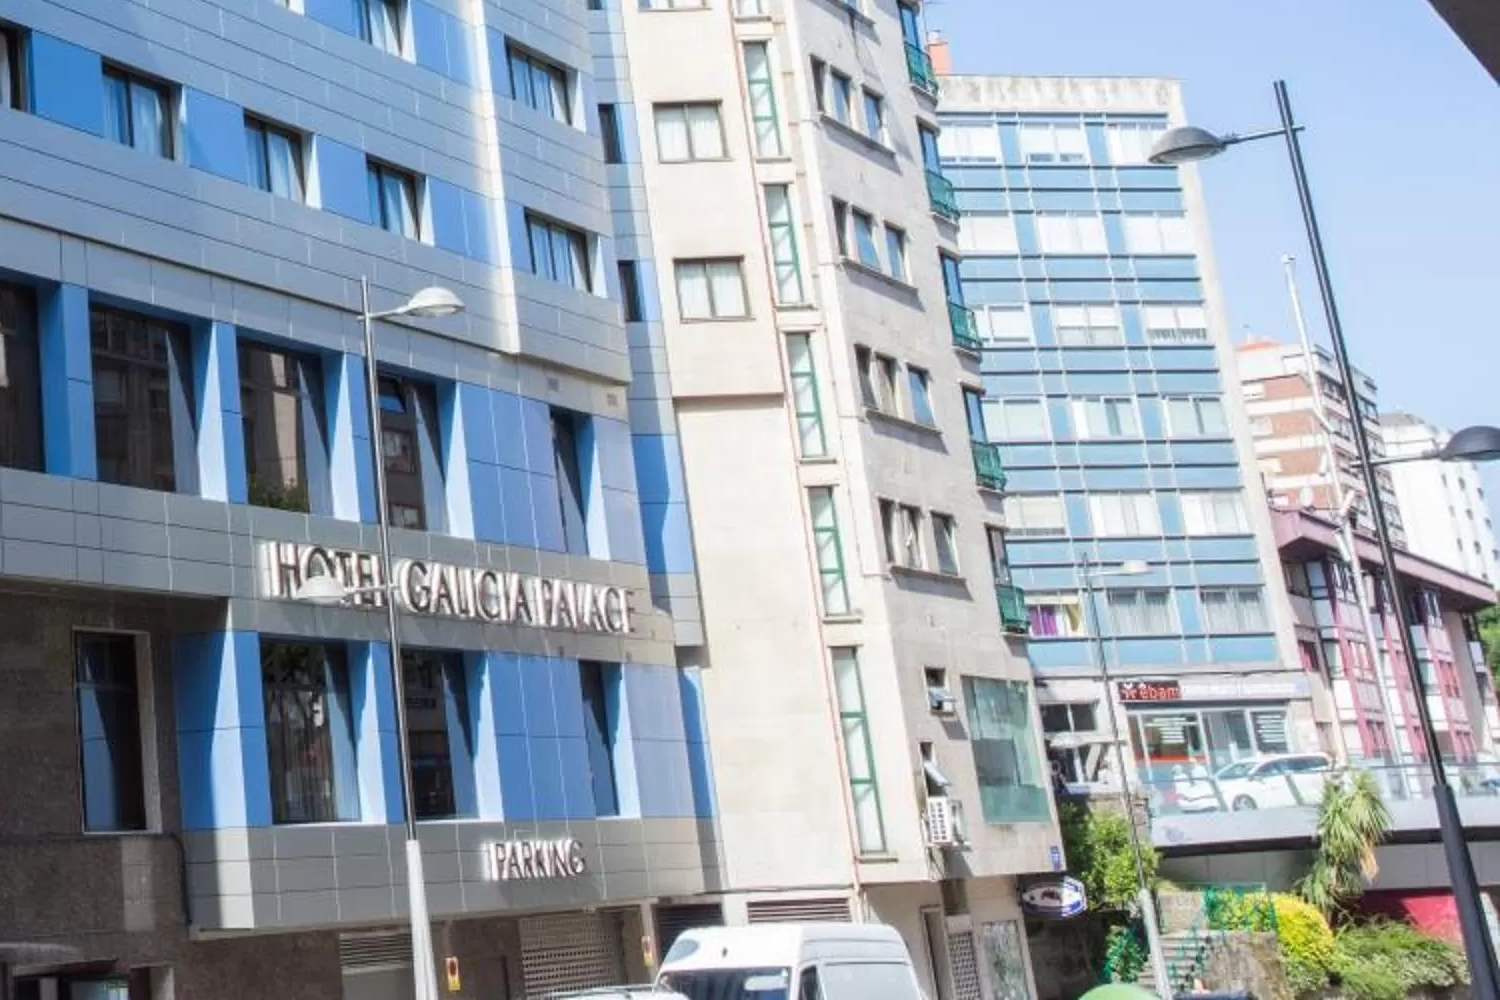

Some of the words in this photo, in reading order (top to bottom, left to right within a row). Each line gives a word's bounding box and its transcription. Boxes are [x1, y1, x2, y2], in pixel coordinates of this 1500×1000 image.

[259, 539, 389, 607] HOTEL
[396, 557, 533, 624] GALICIA
[532, 575, 636, 634] PALACE
[482, 838, 586, 881] PARKING
